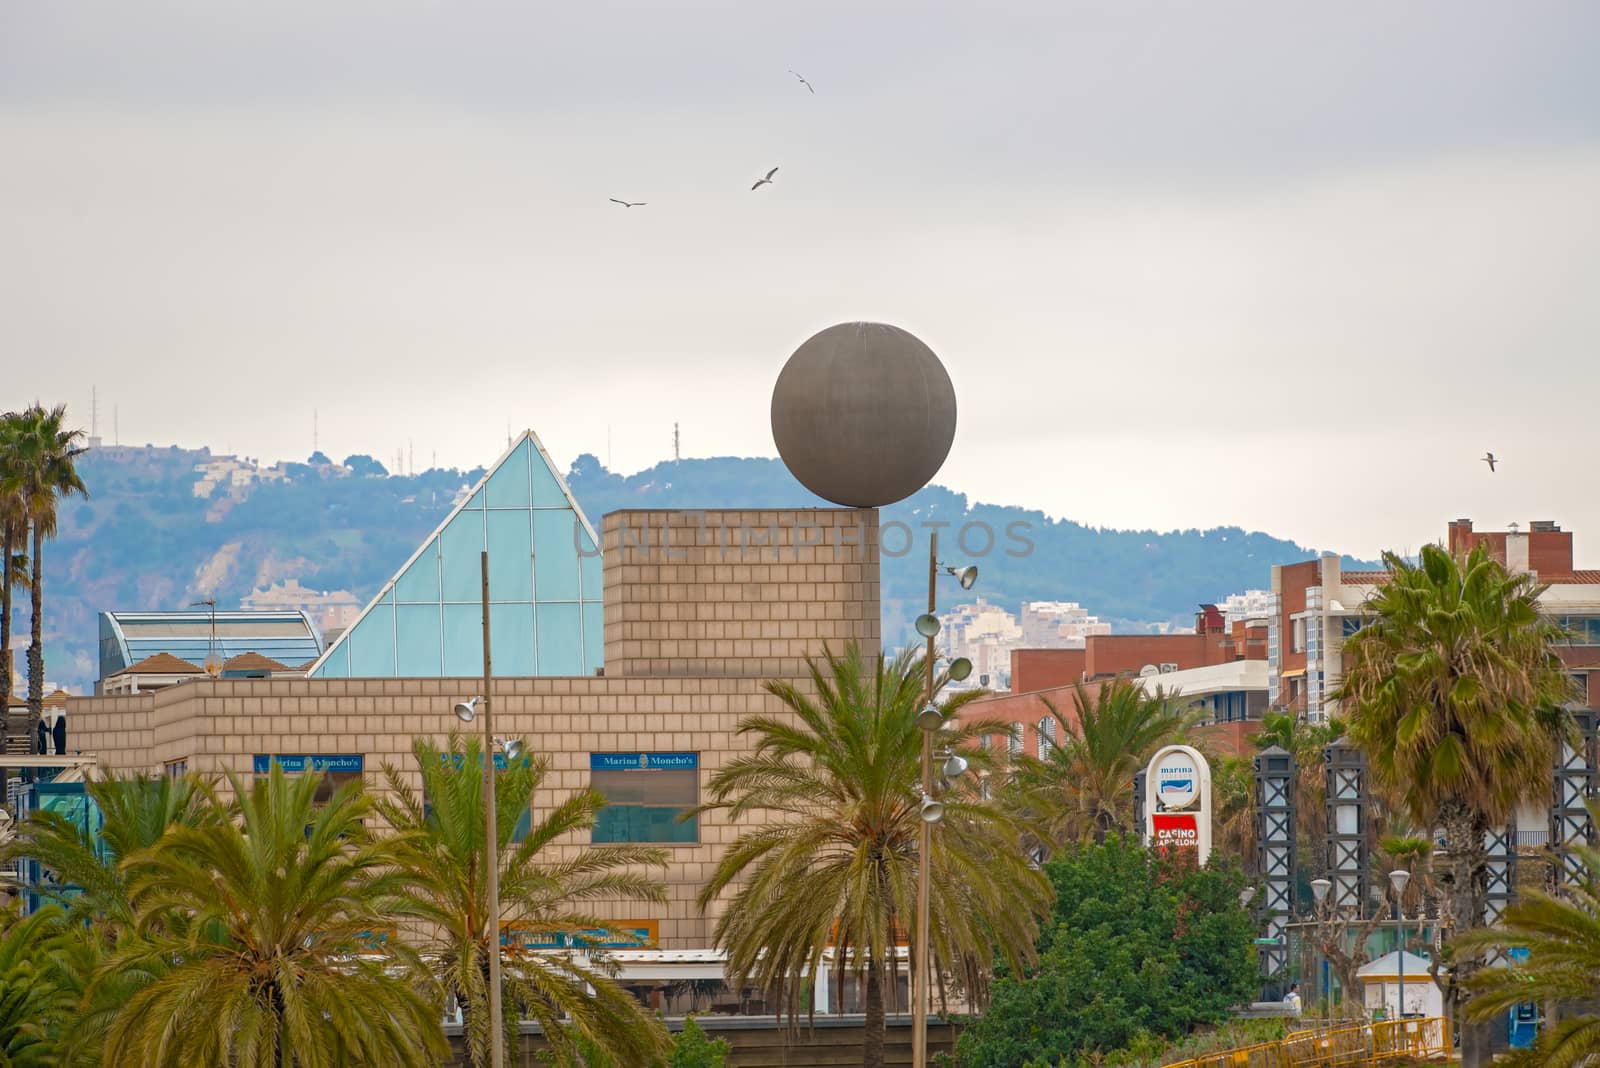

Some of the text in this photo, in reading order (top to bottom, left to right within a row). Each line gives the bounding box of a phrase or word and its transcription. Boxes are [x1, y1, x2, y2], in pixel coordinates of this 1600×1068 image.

[604, 756, 693, 765] Marina Moncho's
[1158, 829, 1195, 839] CASINO
